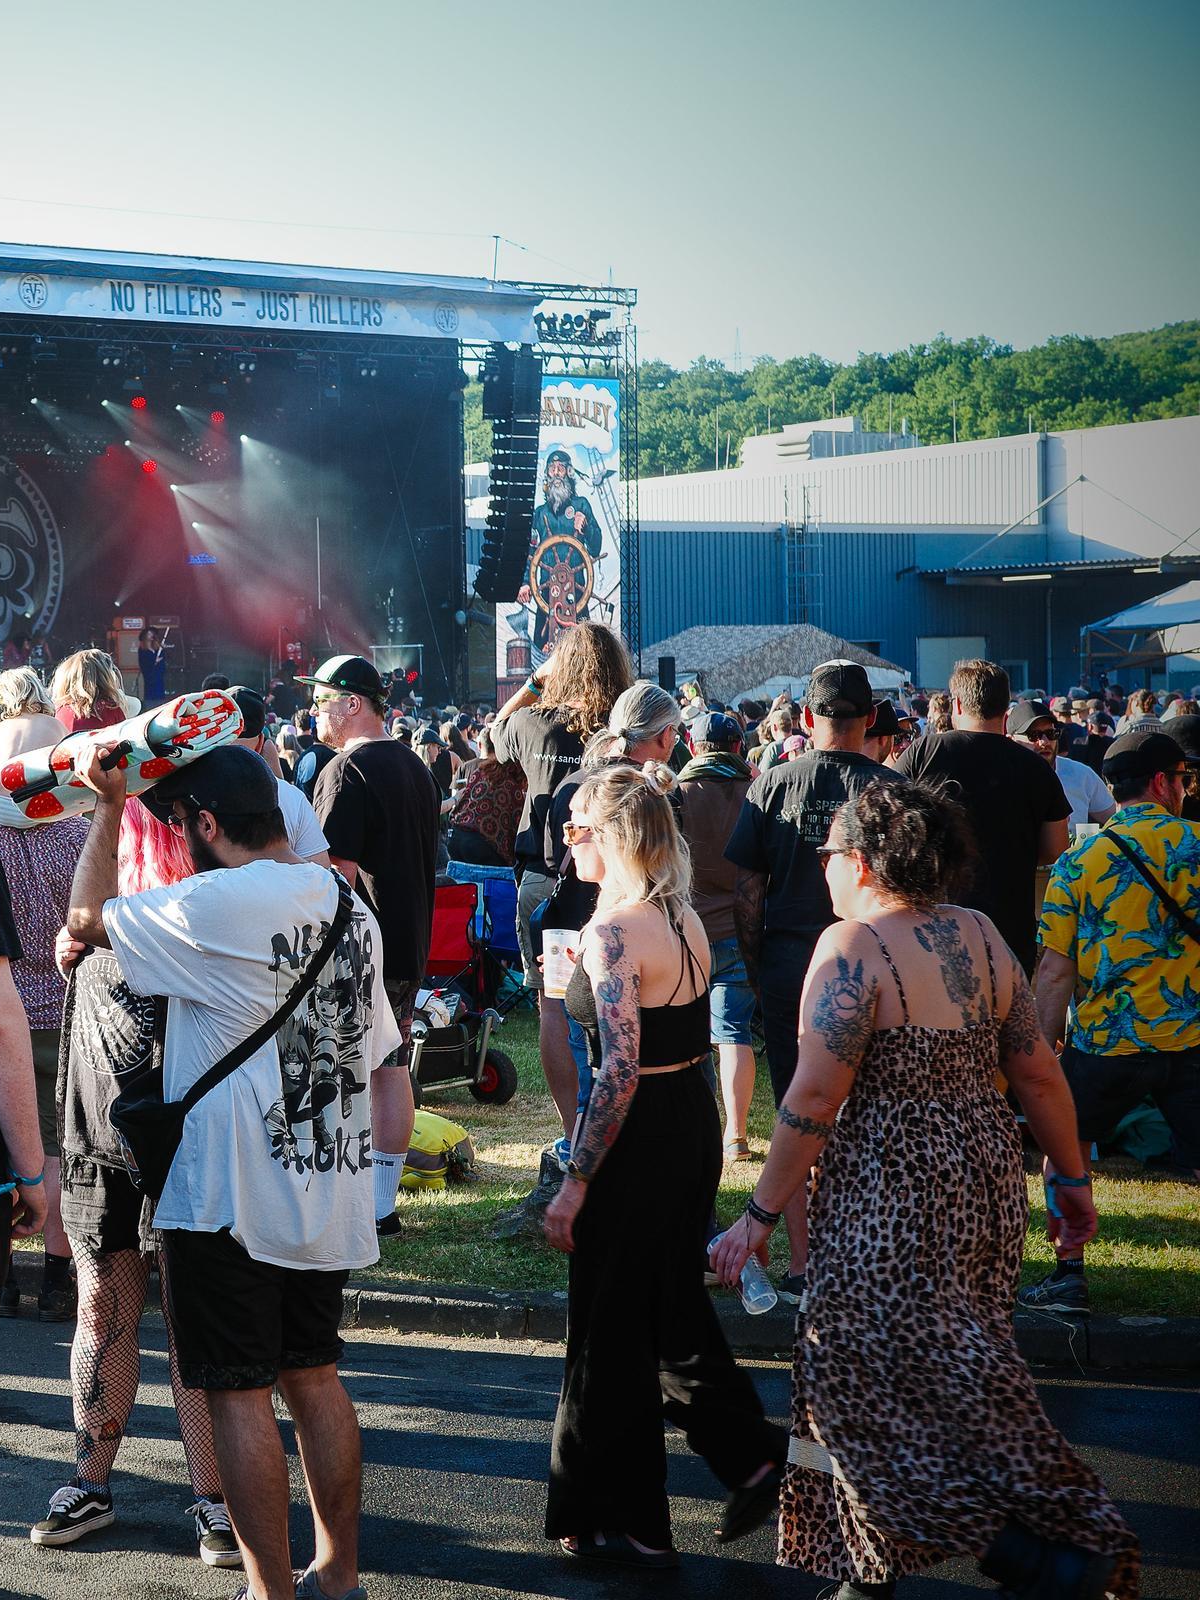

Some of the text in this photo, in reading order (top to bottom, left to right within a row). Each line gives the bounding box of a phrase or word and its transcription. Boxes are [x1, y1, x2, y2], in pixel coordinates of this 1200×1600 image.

[109, 281, 135, 312] NO
[144, 283, 222, 317] FILLERS
[256, 291, 300, 322] JUST
[308, 294, 383, 327] KILLERS
[557, 397, 611, 432] VALLEY
[815, 799, 843, 813] SPEE
